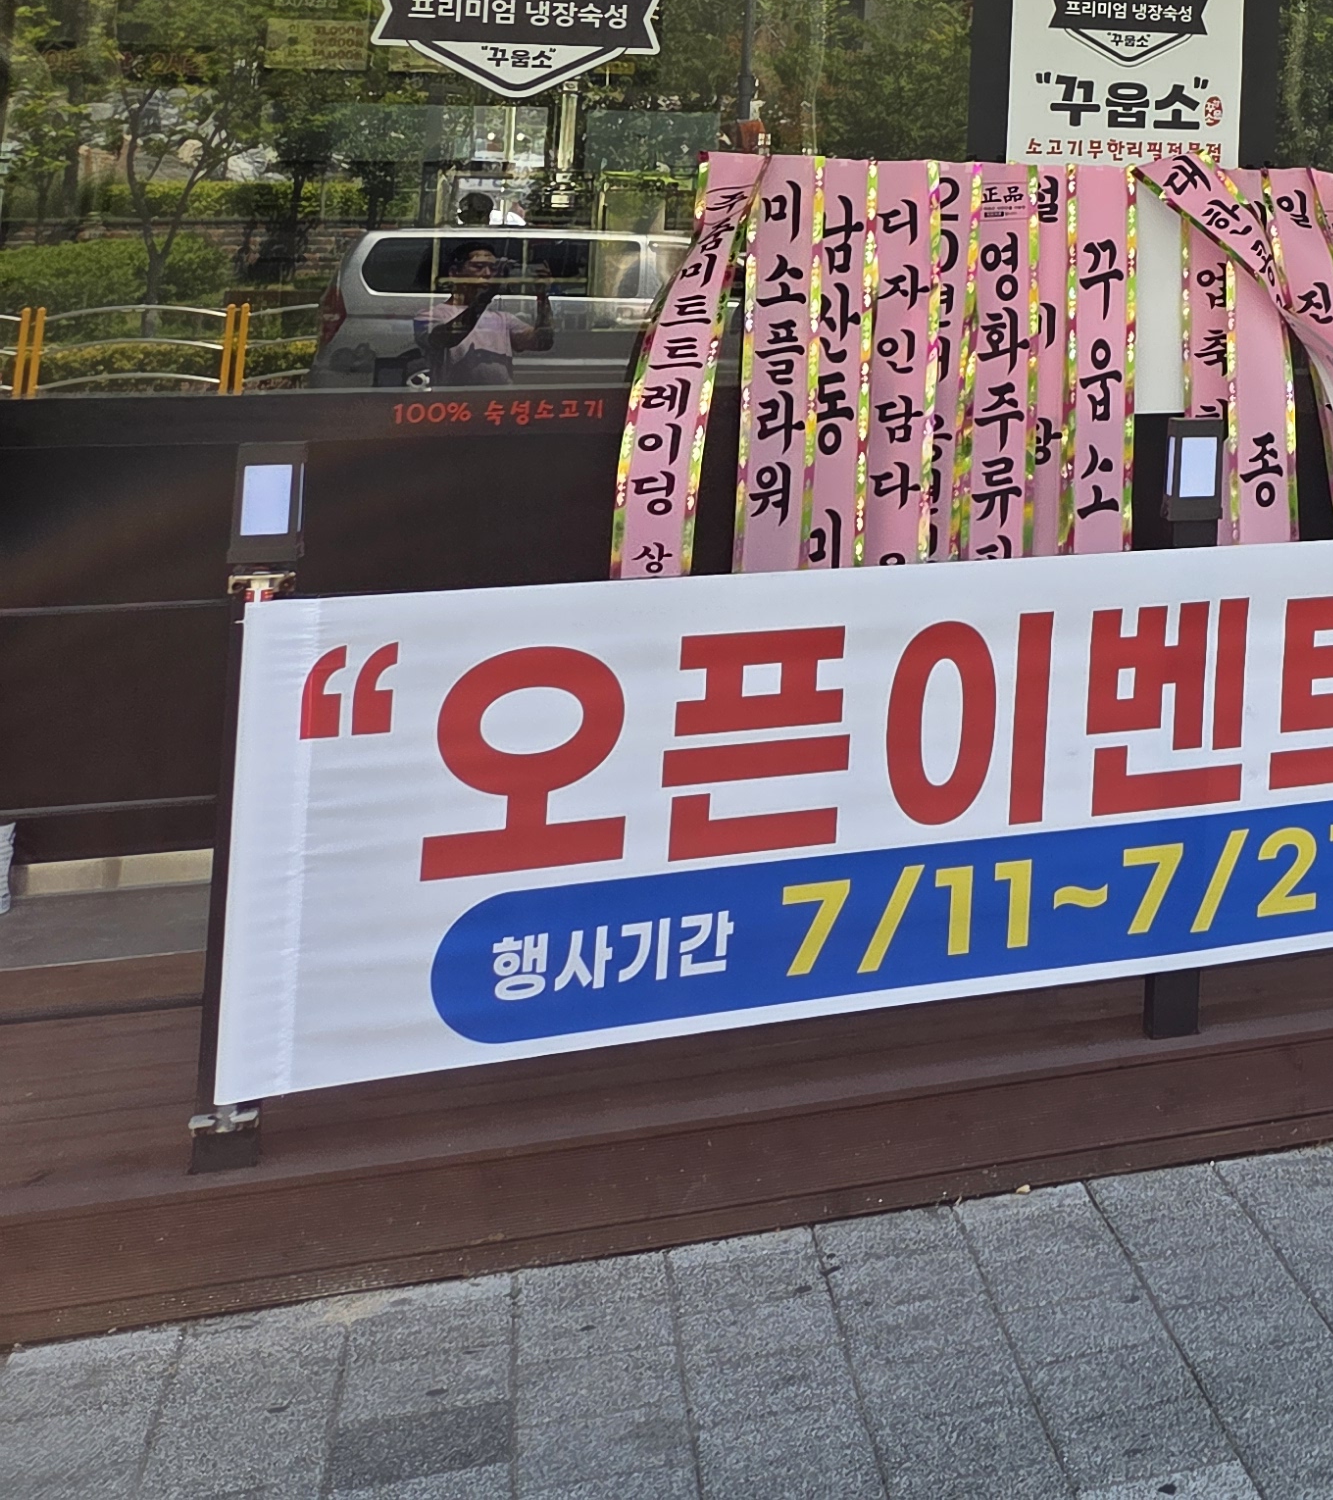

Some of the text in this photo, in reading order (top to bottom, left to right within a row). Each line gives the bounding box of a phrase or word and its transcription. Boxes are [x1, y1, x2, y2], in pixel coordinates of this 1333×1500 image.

[525, 1, 629, 29] 냉장숙성
[1064, 0, 1193, 23] 프리미엄 냉장숙성
[394, 400, 604, 426] 100% 숙성소고기
[492, 913, 735, 1002] 행사기간
